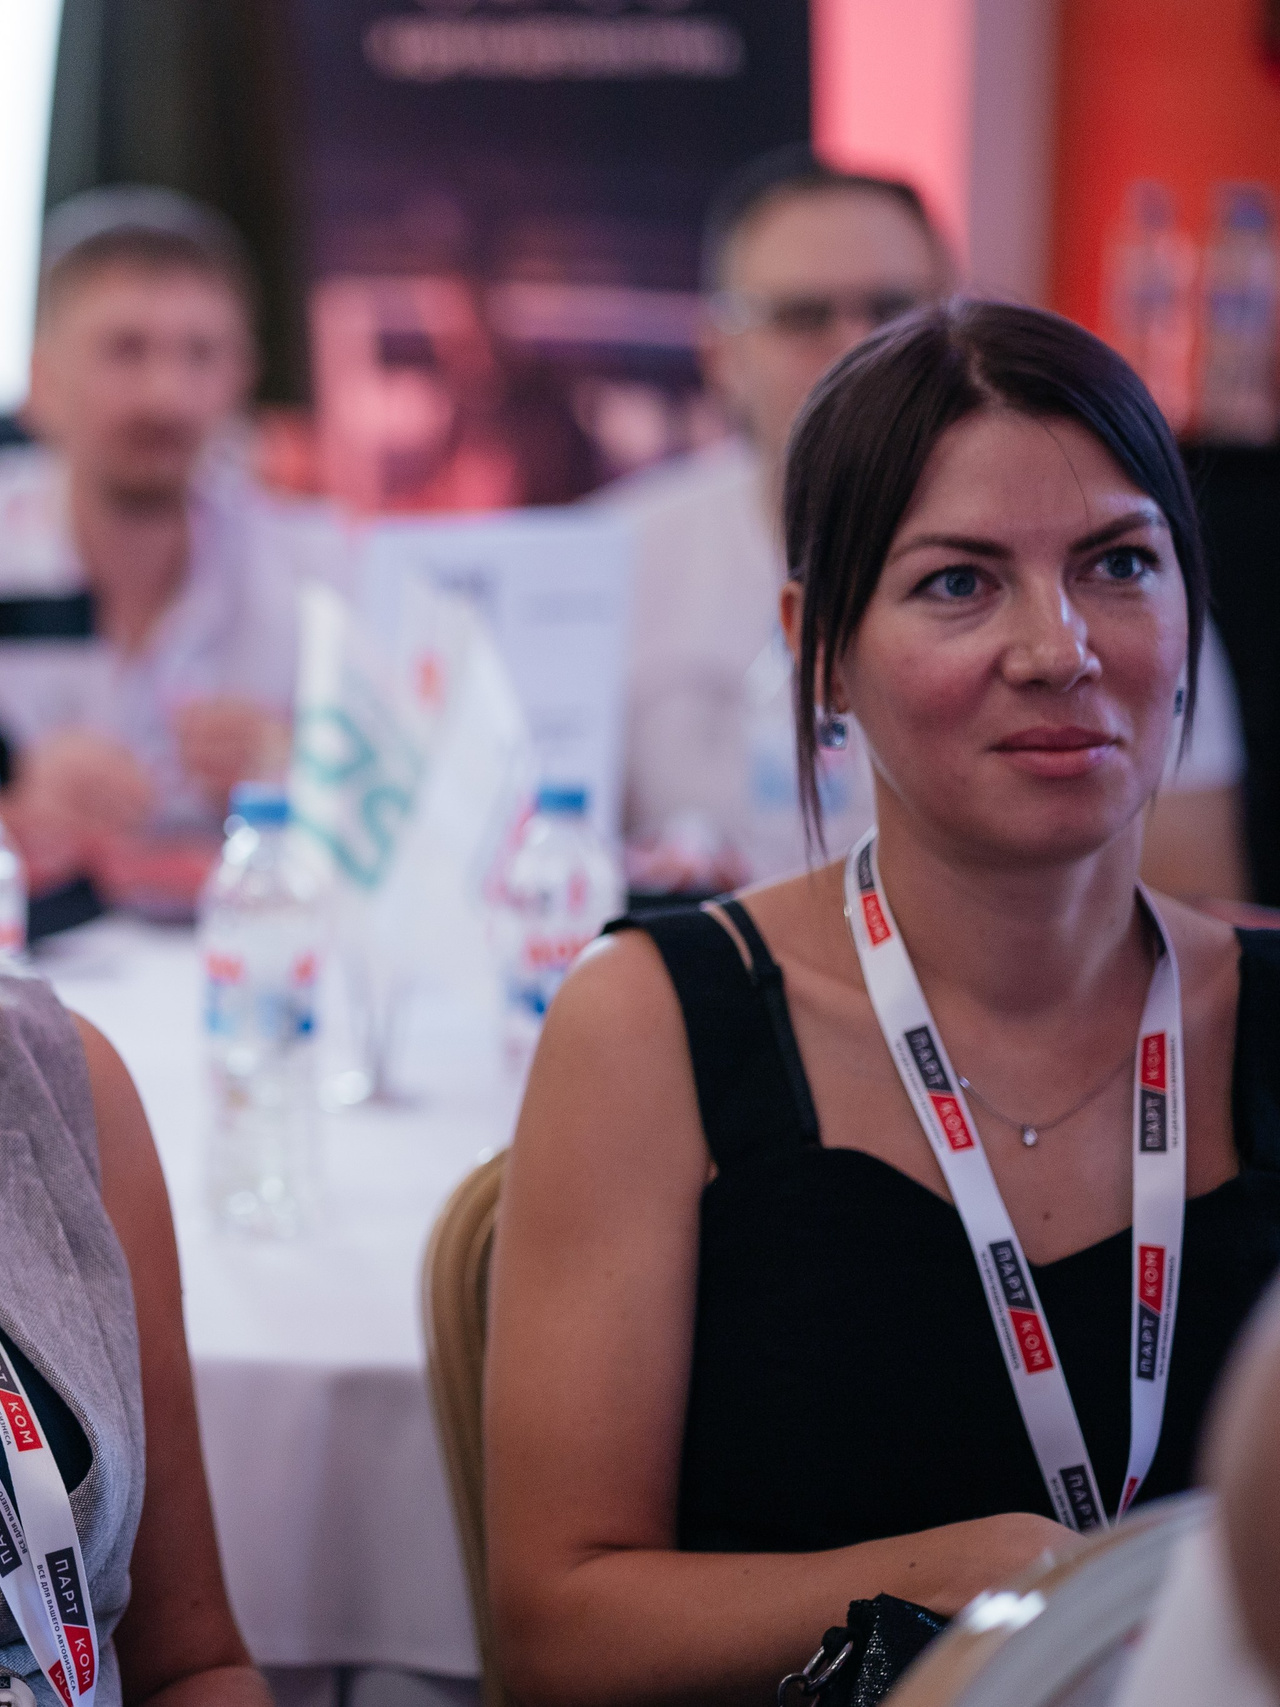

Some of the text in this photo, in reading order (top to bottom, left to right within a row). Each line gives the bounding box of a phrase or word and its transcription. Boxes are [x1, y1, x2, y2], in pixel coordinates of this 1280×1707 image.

[911, 1032, 944, 1085] ПАРТ
[940, 1101, 969, 1146] КОМ
[1145, 1040, 1161, 1148] ПАРТ КОМ
[996, 1246, 1027, 1301] ПАРТ
[1020, 1319, 1046, 1366] КОМ
[1140, 1250, 1159, 1373] ПАРТ КОМ
[8, 1401, 34, 1444] КОМ
[10, 1522, 23, 1538] ДЛЯ
[17, 1540, 28, 1554] ВСЕ
[36, 1564, 76, 1691] ВСЕ ДЛЯ ВАШЕГО АВТОБИЗНЕСА
[55, 1559, 91, 1685] ПАРТ КОМ
